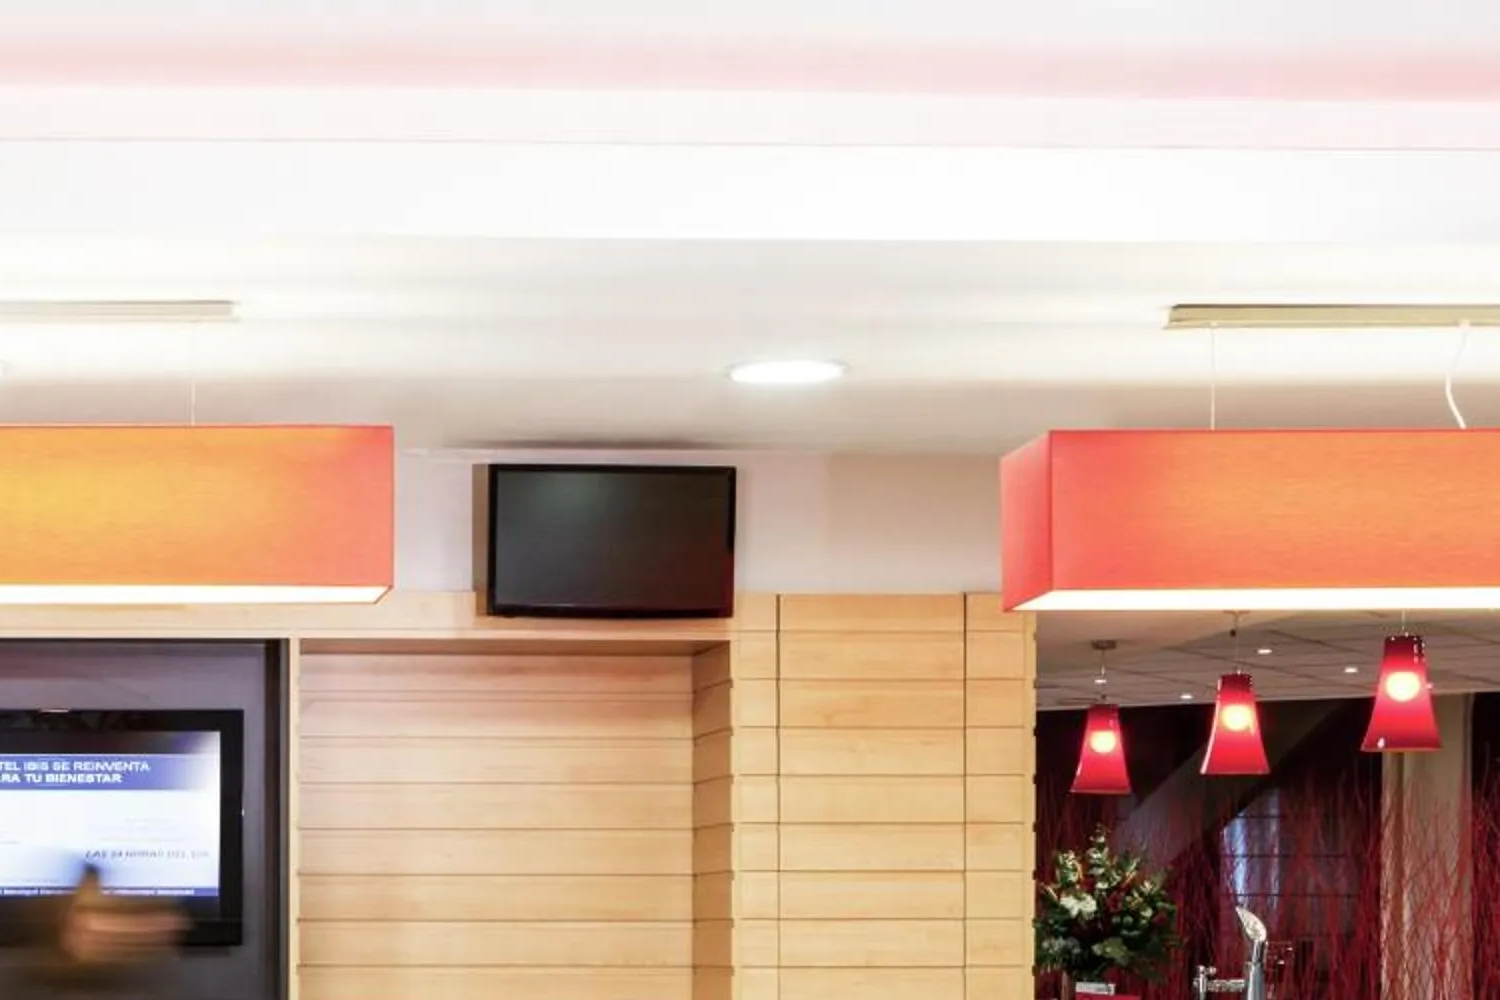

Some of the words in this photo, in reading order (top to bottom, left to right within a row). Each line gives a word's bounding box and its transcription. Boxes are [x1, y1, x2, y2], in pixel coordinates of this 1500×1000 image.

[23, 761, 49, 771] IBIS
[53, 761, 70, 771] SE
[73, 761, 151, 771] REINVENTA
[25, 773, 42, 783] TU
[45, 773, 123, 783] BIENESTAR
